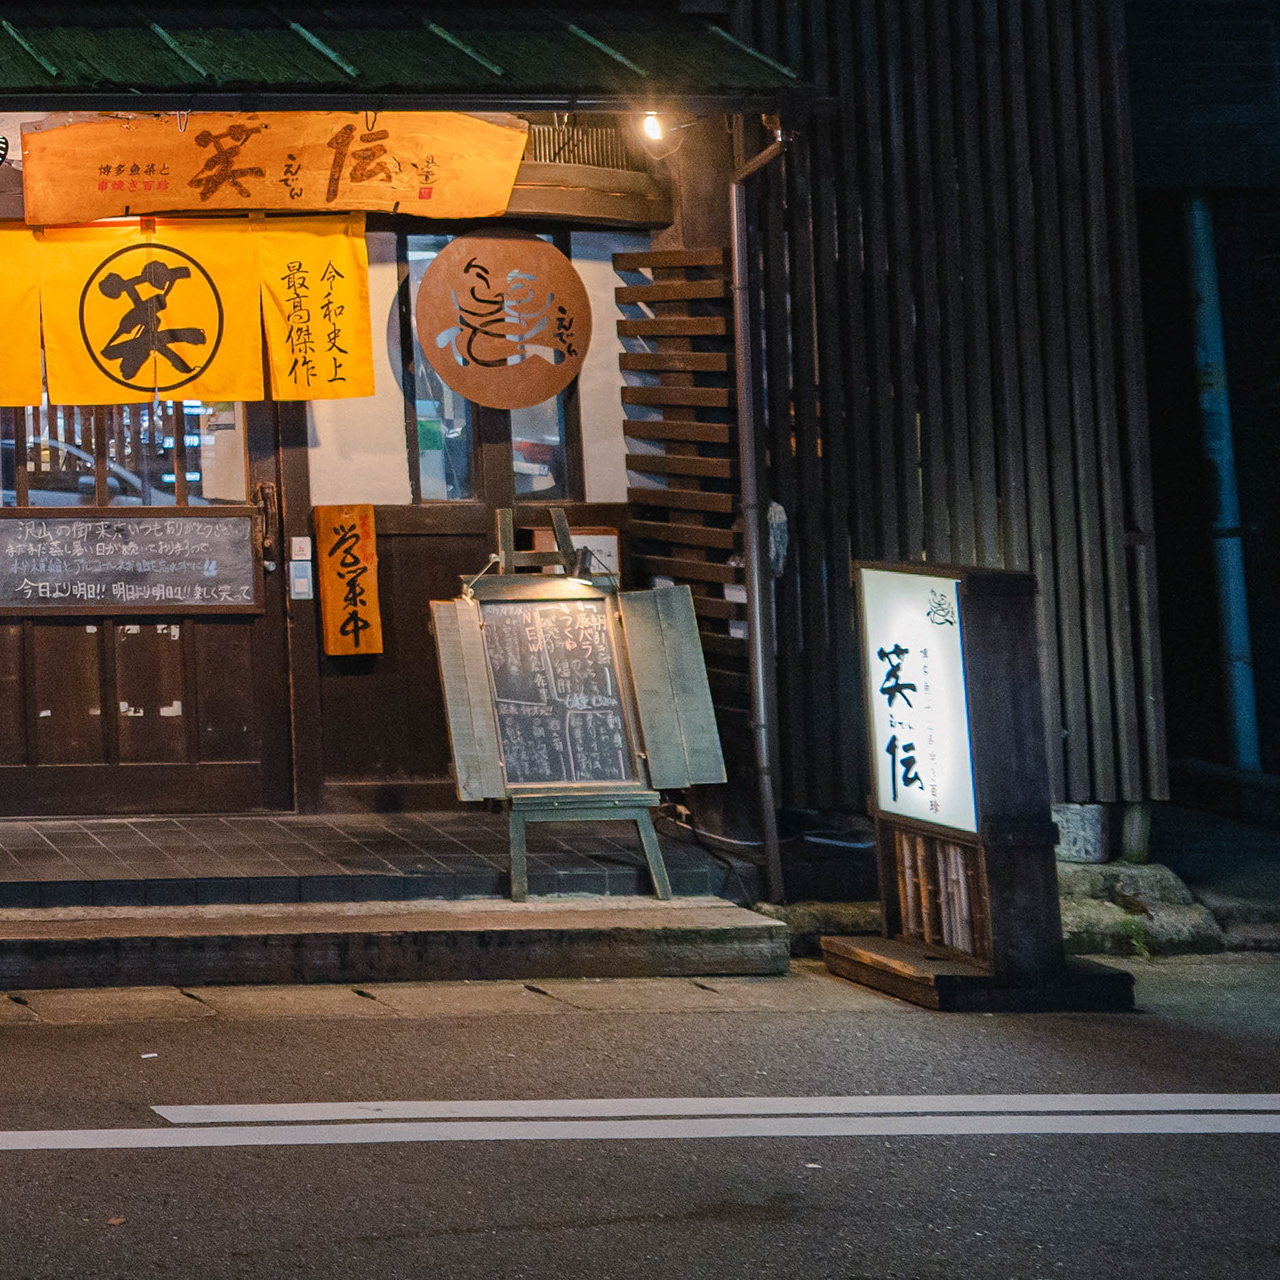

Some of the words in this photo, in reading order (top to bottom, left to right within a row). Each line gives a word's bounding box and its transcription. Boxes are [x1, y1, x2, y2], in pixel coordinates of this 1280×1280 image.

[100, 260, 207, 382] 笑
[280, 261, 317, 388] 最高傑作
[320, 259, 348, 384] 令和史上
